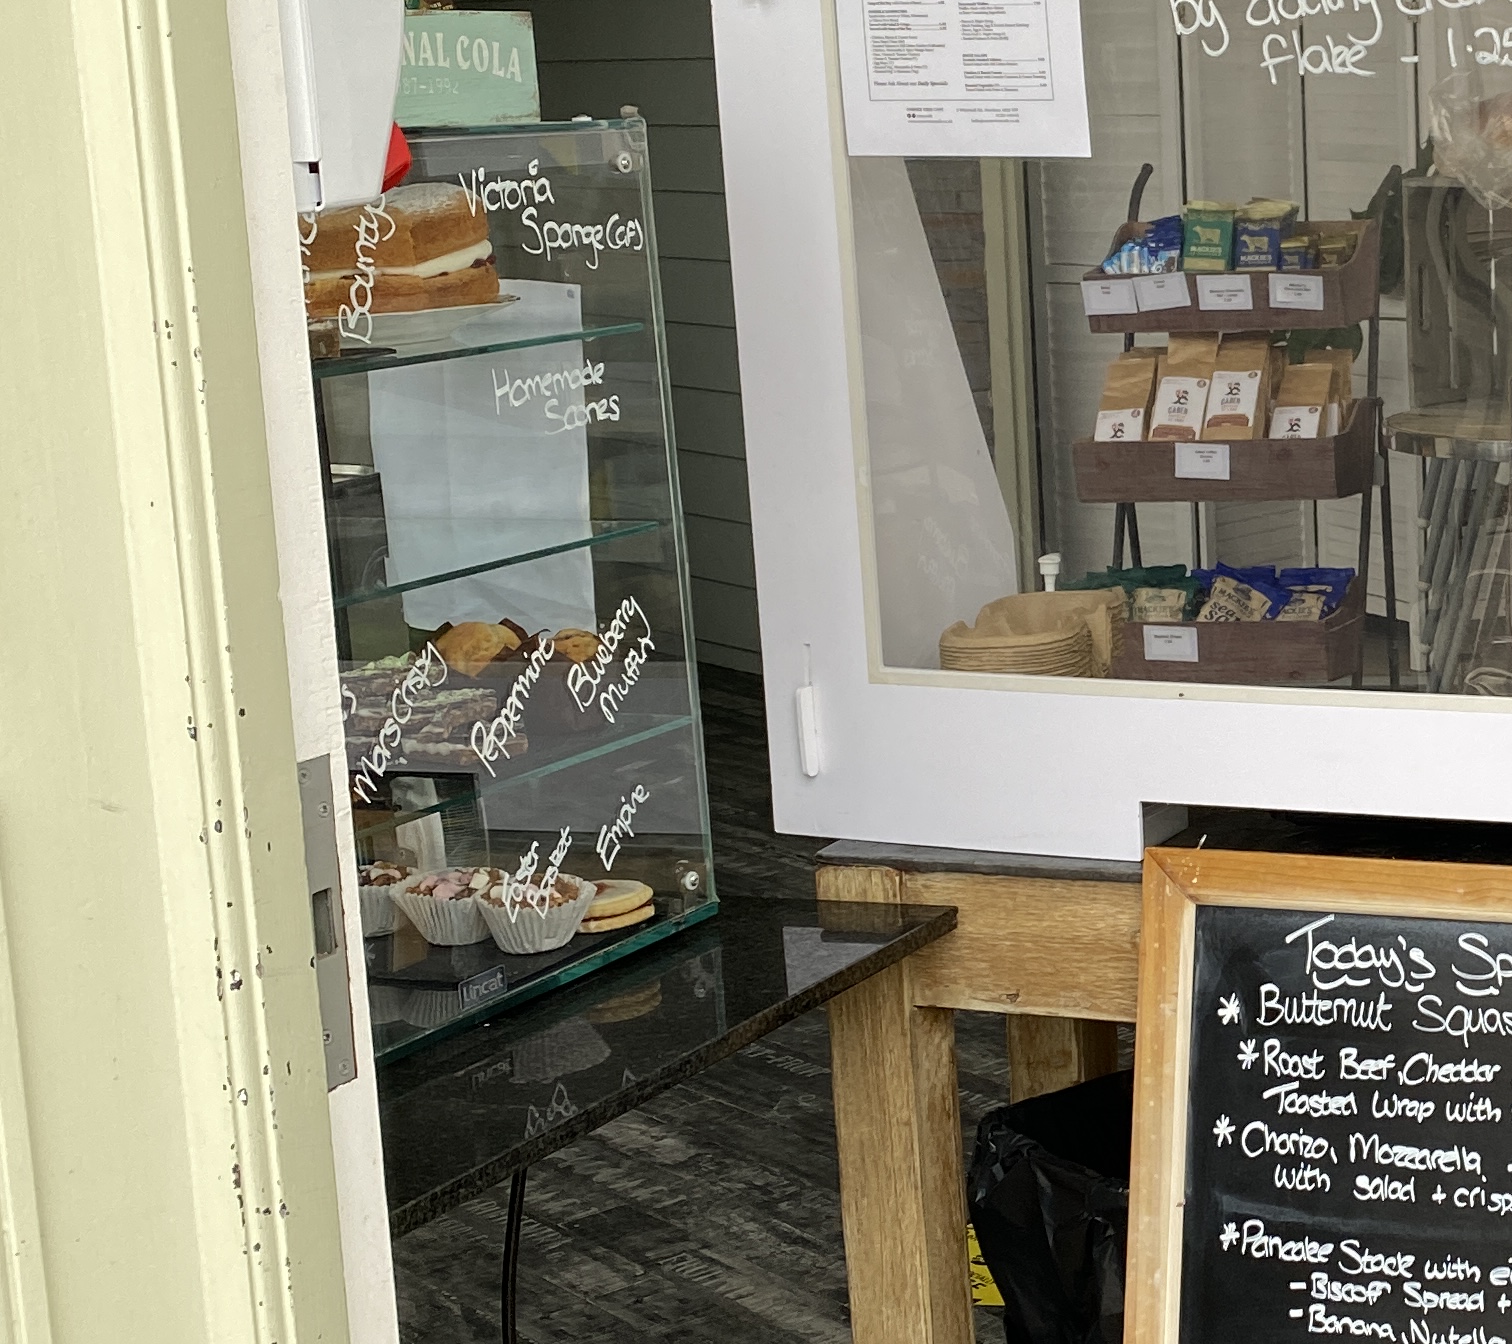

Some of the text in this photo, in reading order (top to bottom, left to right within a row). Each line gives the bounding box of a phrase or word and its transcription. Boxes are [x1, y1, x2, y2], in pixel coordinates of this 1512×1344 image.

[456, 35, 522, 83] COLA
[1261, 33, 1377, 85] flake
[458, 158, 554, 217] Victoria
[491, 360, 605, 415] Homemade
[544, 394, 619, 436] Scones
[567, 596, 650, 712] Blueberry
[600, 637, 655, 723] Muffin
[471, 638, 554, 777] Peppermint
[354, 718, 401, 803] Mars
[596, 784, 649, 871] Empire
[1285, 914, 1436, 987] Today's
[463, 967, 506, 1003] Lincat
[1256, 984, 1392, 1031] Butternut
[1264, 1038, 1326, 1080] Roast
[1403, 1053, 1501, 1086] Cheddar
[1263, 1081, 1357, 1115] Toasted
[1372, 1090, 1435, 1123] Wrap
[1446, 1092, 1502, 1123] with
[1350, 1133, 1482, 1173] Mozzarella
[1274, 1162, 1331, 1192] with
[1353, 1174, 1416, 1203] salad
[1241, 1218, 1334, 1263] Pancake
[1338, 1239, 1415, 1278] Stack
[1424, 1255, 1481, 1283] with
[1403, 1281, 1484, 1315] Spread
